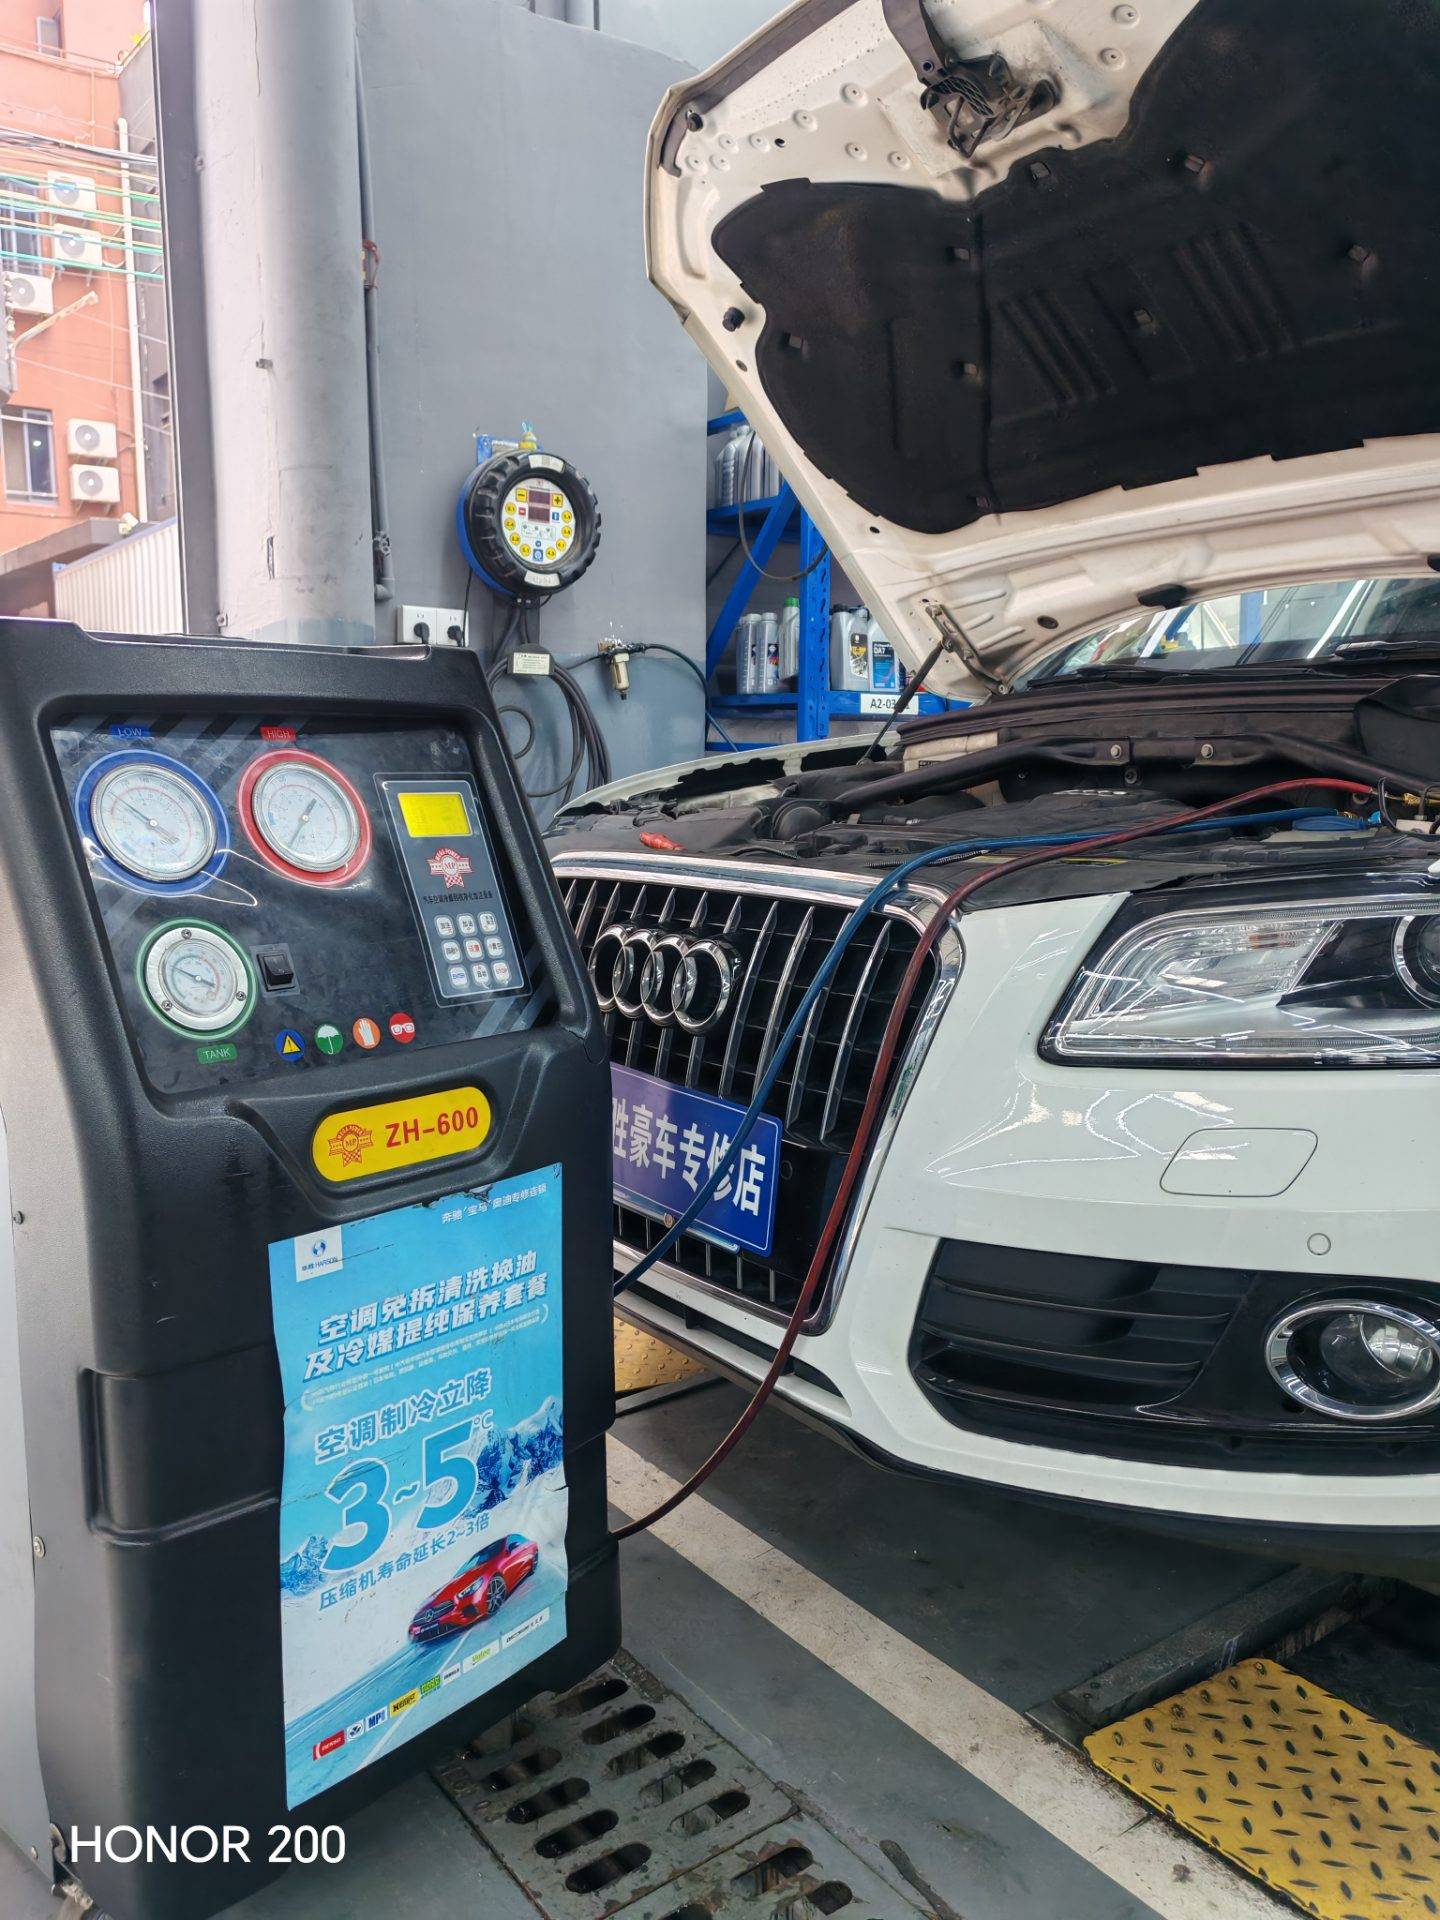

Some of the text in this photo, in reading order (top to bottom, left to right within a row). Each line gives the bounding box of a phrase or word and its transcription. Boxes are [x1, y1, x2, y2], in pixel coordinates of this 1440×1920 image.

[870, 698, 910, 710] A2-03
[117, 727, 143, 738] LOW
[267, 729, 291, 740] HIGH
[203, 1048, 231, 1060] TANK
[385, 1106, 479, 1148] ZH-600
[318, 1251, 537, 1345] 空调免拆清洗换油
[303, 1272, 549, 1381] 及冷媒提纯保养套餐
[315, 1368, 493, 1465] 空调制冷立降
[319, 1512, 490, 1611] 压缩机寿命延长2~3倍
